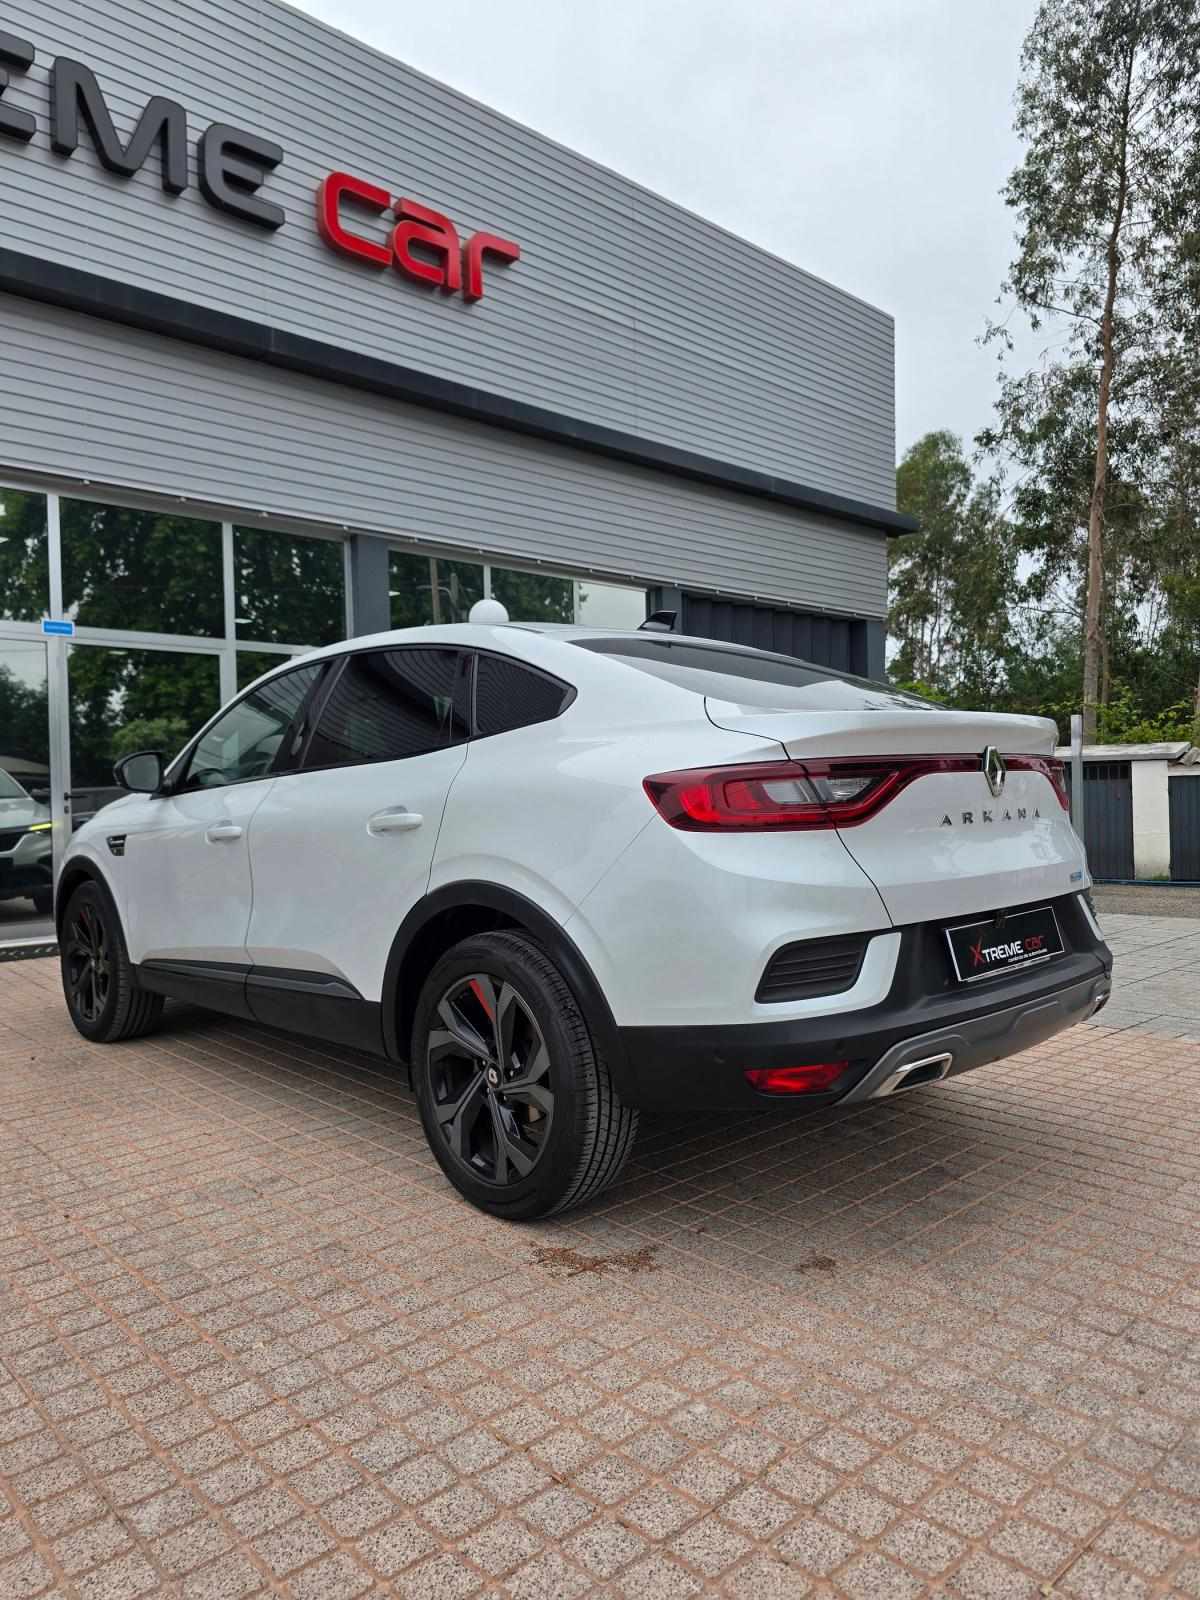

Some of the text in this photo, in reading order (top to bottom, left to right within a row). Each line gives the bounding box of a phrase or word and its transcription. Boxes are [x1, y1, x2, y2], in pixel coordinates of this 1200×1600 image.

[316, 170, 520, 304] car
[940, 807, 1041, 826] ARKANA
[969, 935, 1024, 967] XTREME
